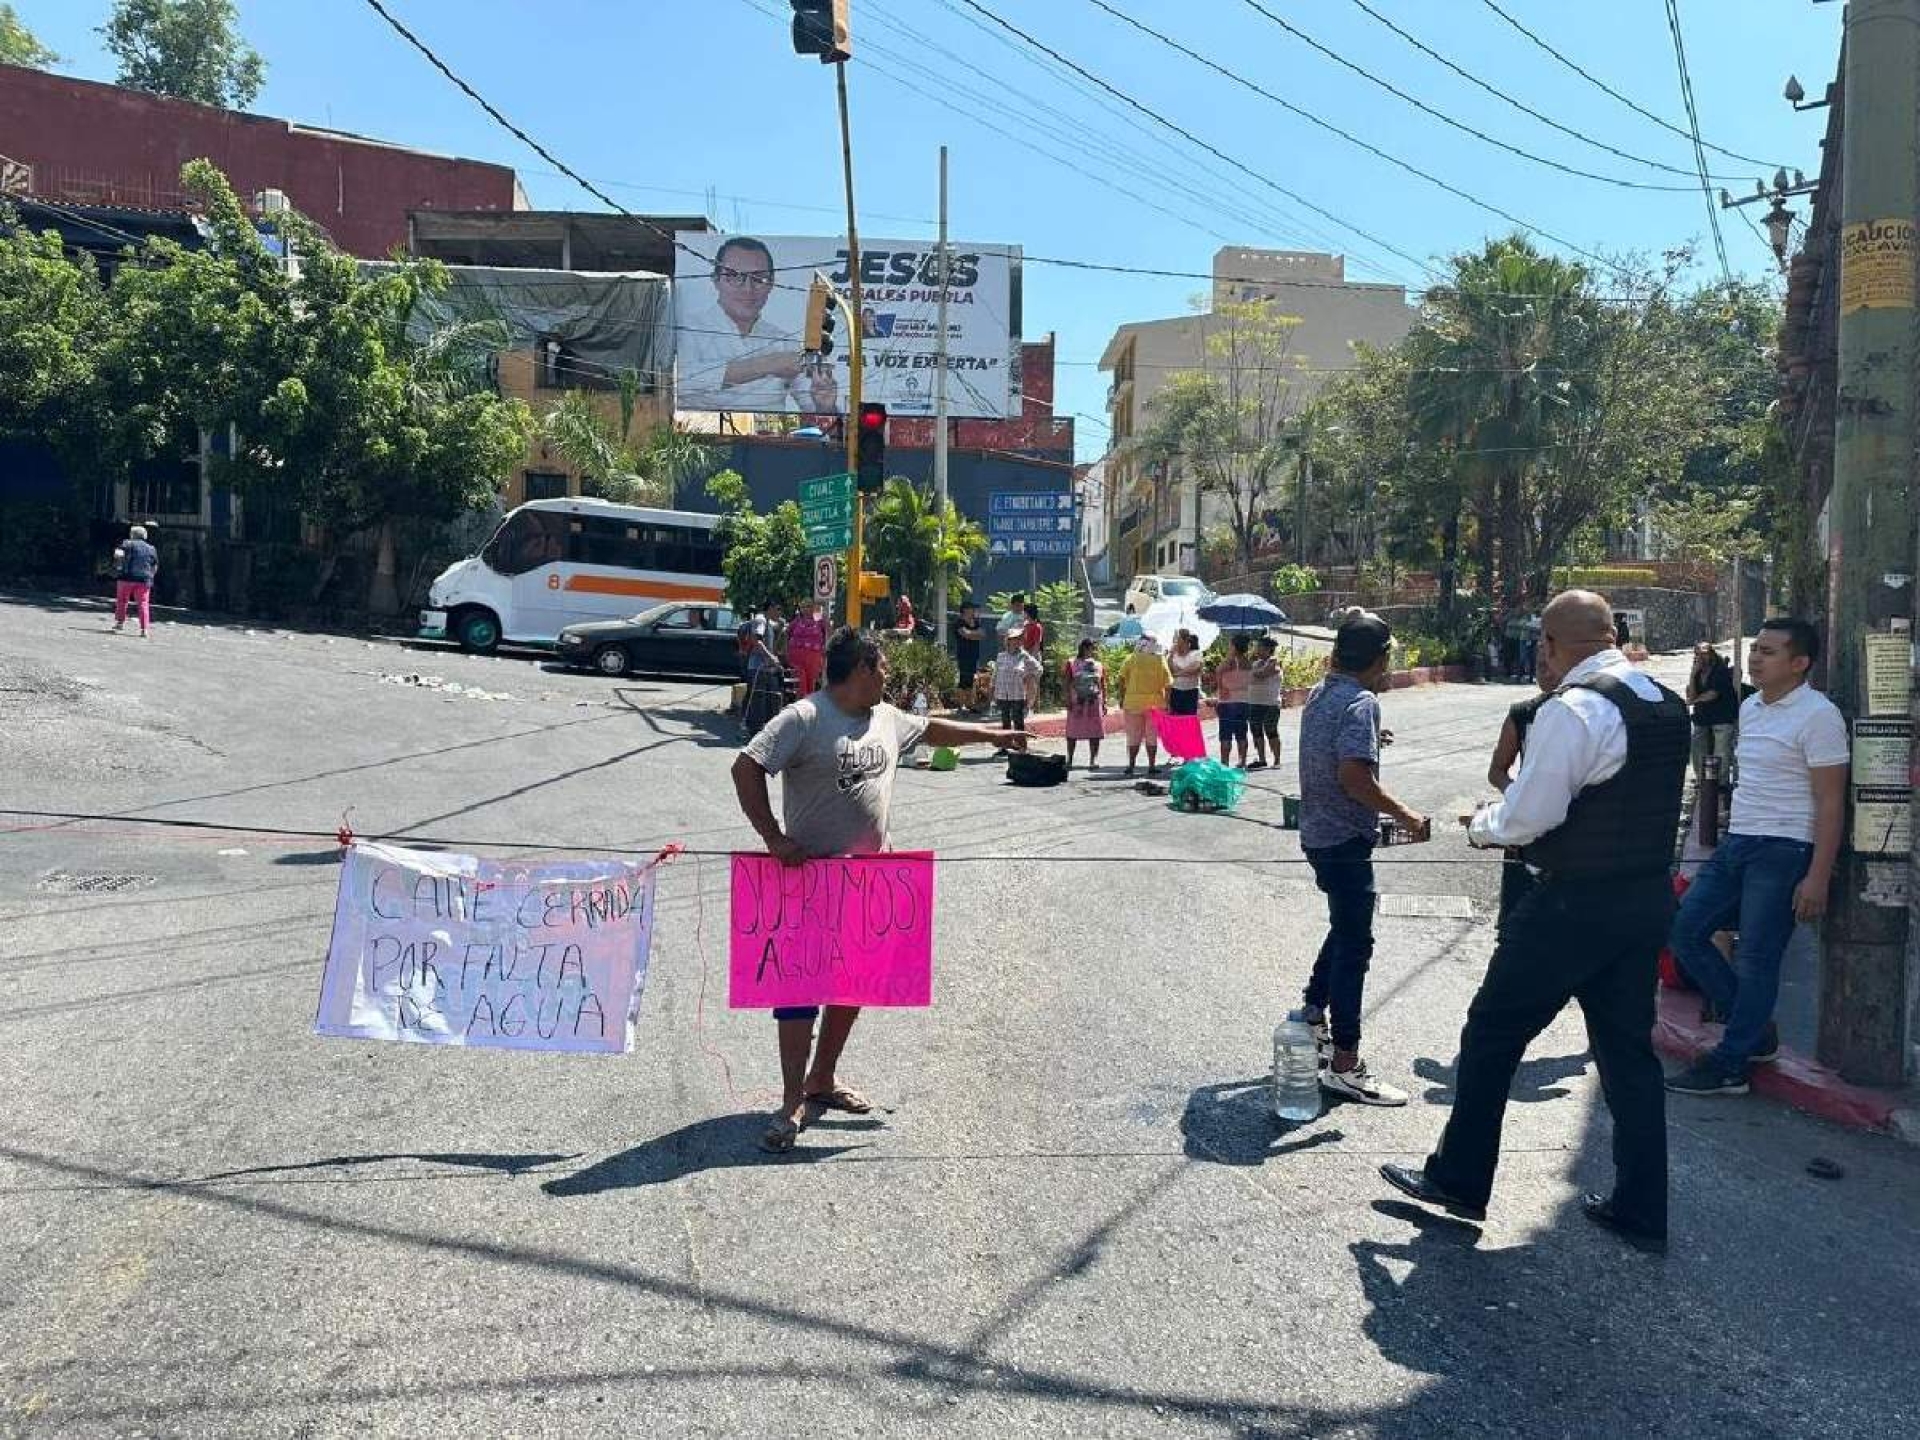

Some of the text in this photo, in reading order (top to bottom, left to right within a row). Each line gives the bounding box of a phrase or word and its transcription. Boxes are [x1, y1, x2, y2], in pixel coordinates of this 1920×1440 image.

[873, 355, 909, 369] VOZ
[372, 935, 445, 992] POR
[756, 936, 850, 985] AGUA
[466, 994, 605, 1039] AGUA
